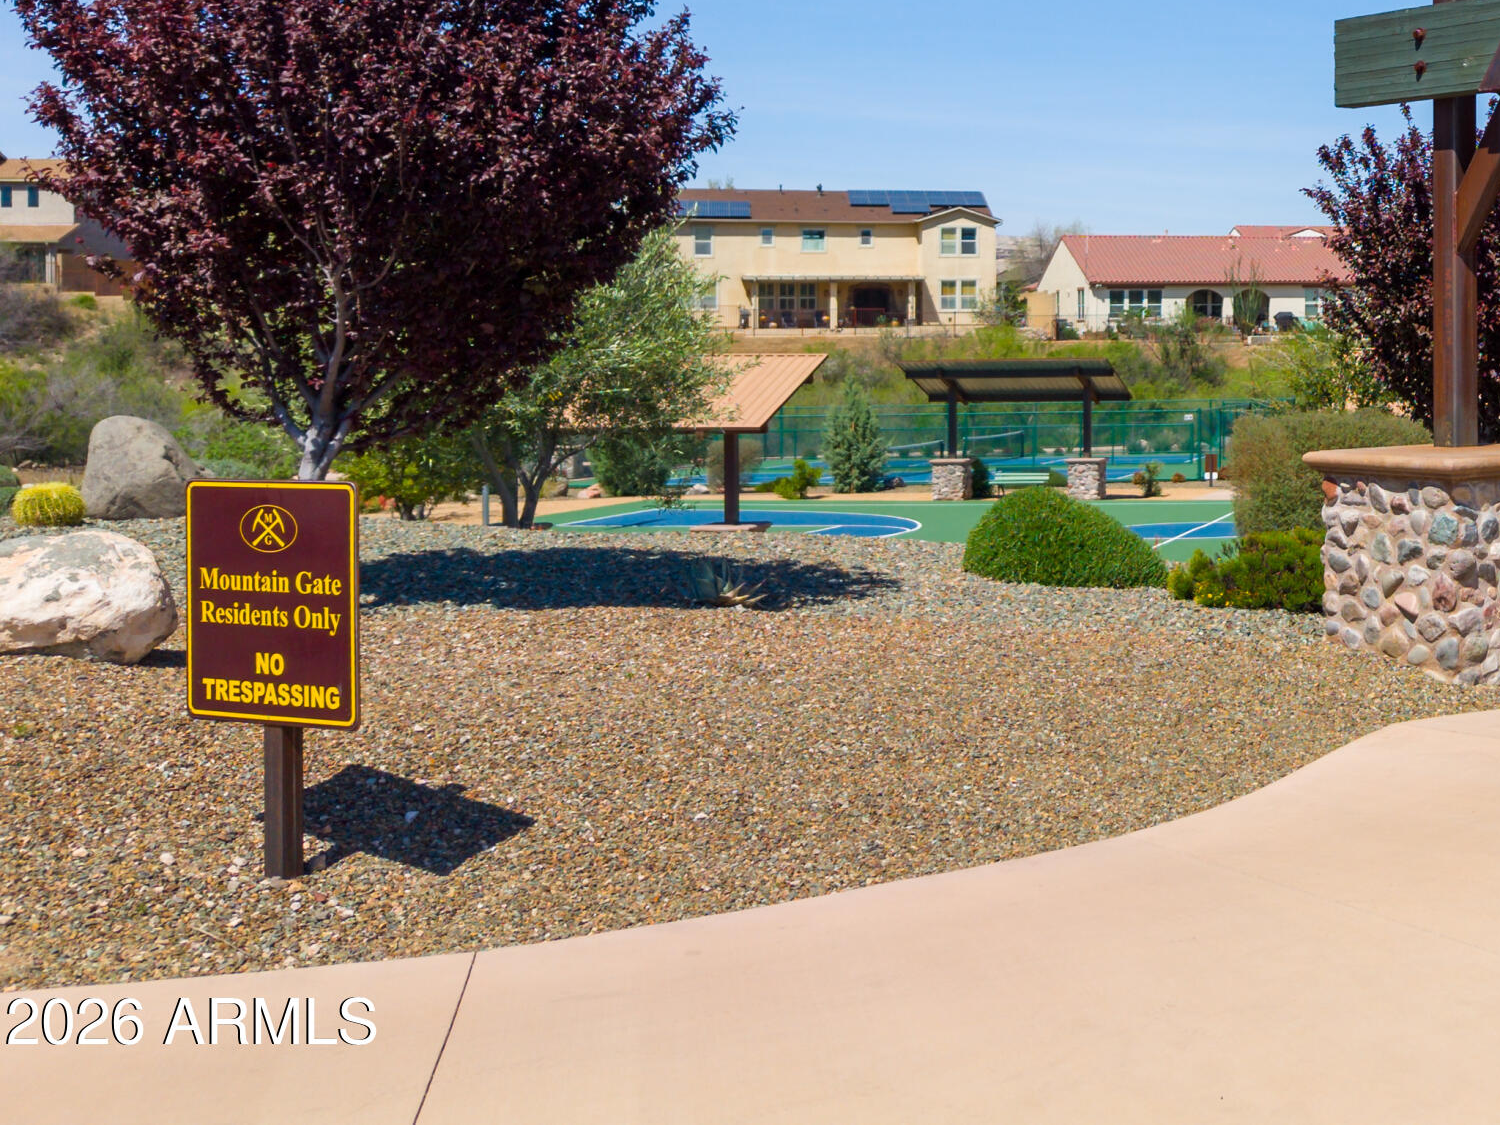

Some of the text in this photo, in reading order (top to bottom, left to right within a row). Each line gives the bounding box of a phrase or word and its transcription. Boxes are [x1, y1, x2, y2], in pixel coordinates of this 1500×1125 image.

[263, 512, 273, 523] M
[264, 535, 272, 546] G
[200, 566, 342, 595] Mountain Gate
[200, 600, 341, 636] Residents Only
[255, 652, 285, 676] NO
[202, 677, 340, 710] TRESPASSING
